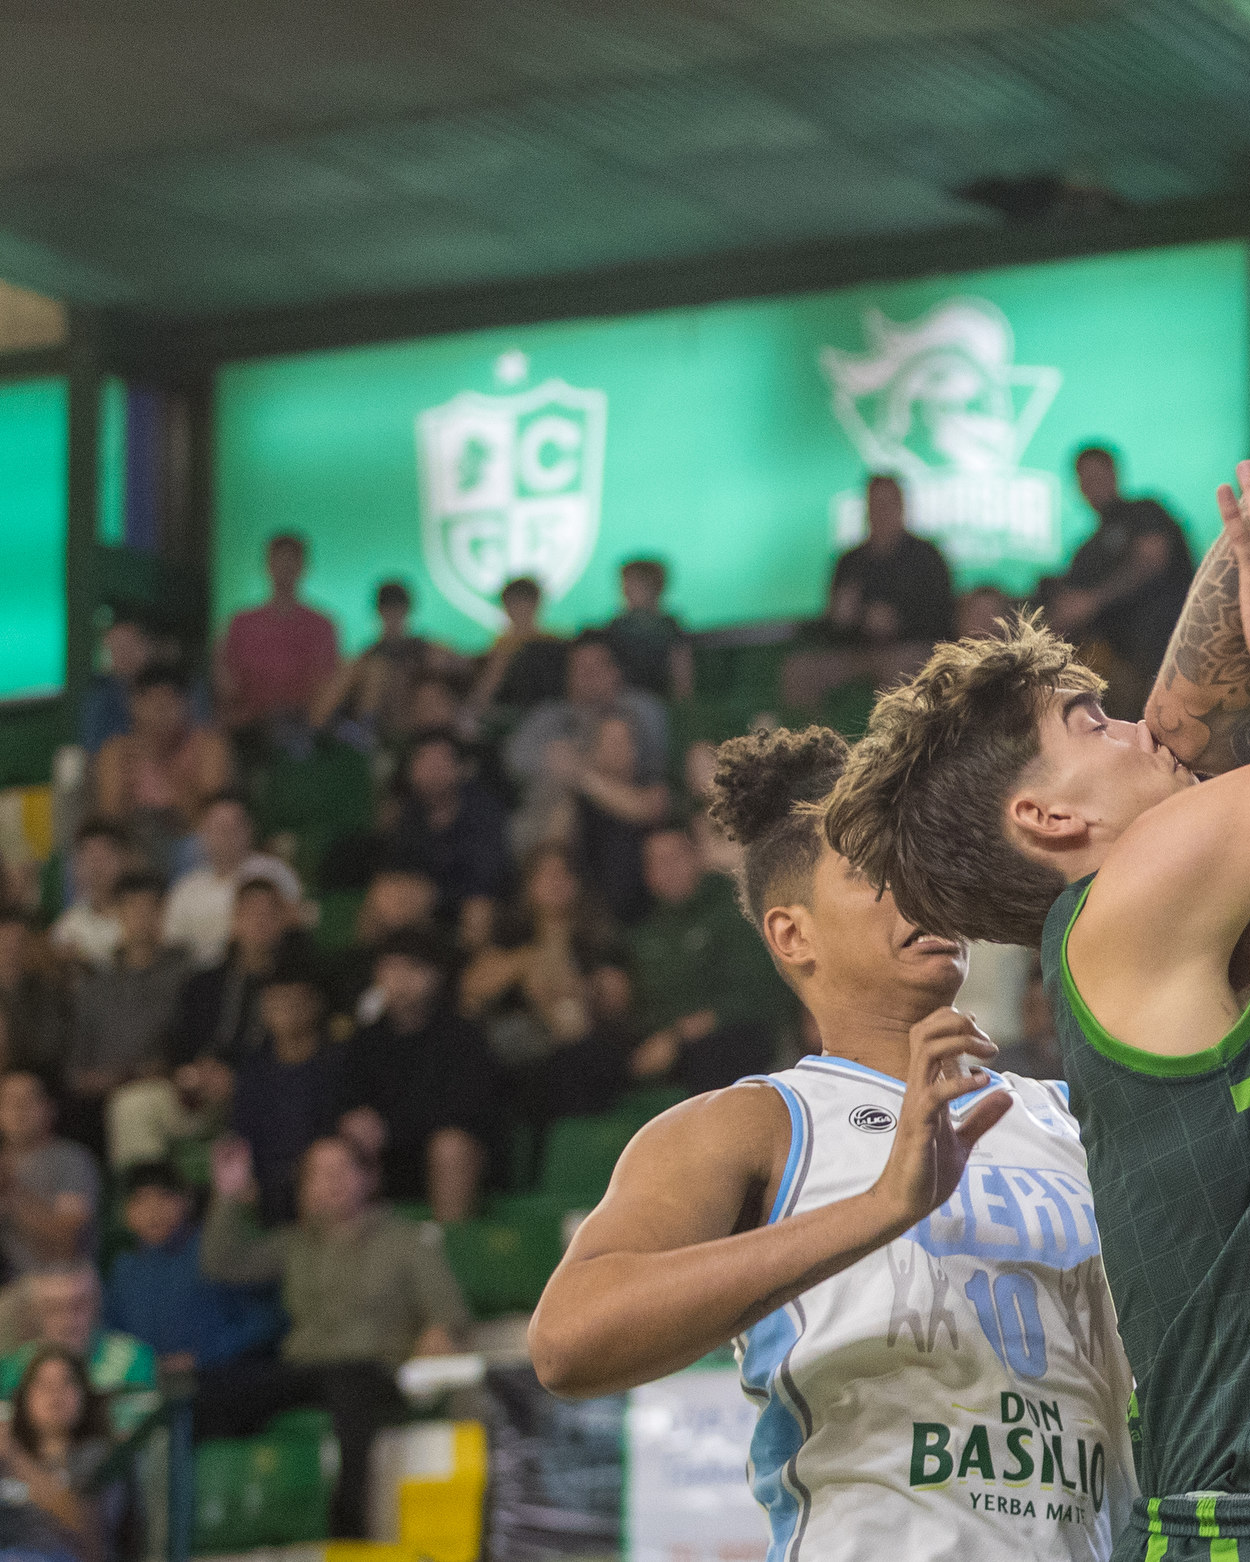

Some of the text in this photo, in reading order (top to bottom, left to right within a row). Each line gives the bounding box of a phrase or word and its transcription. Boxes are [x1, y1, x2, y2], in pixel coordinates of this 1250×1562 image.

[964, 1268, 1049, 1379] 10
[1001, 1391, 1064, 1432] DON
[909, 1421, 1105, 1514] BASILIO
[969, 1492, 1037, 1518] YERBA
